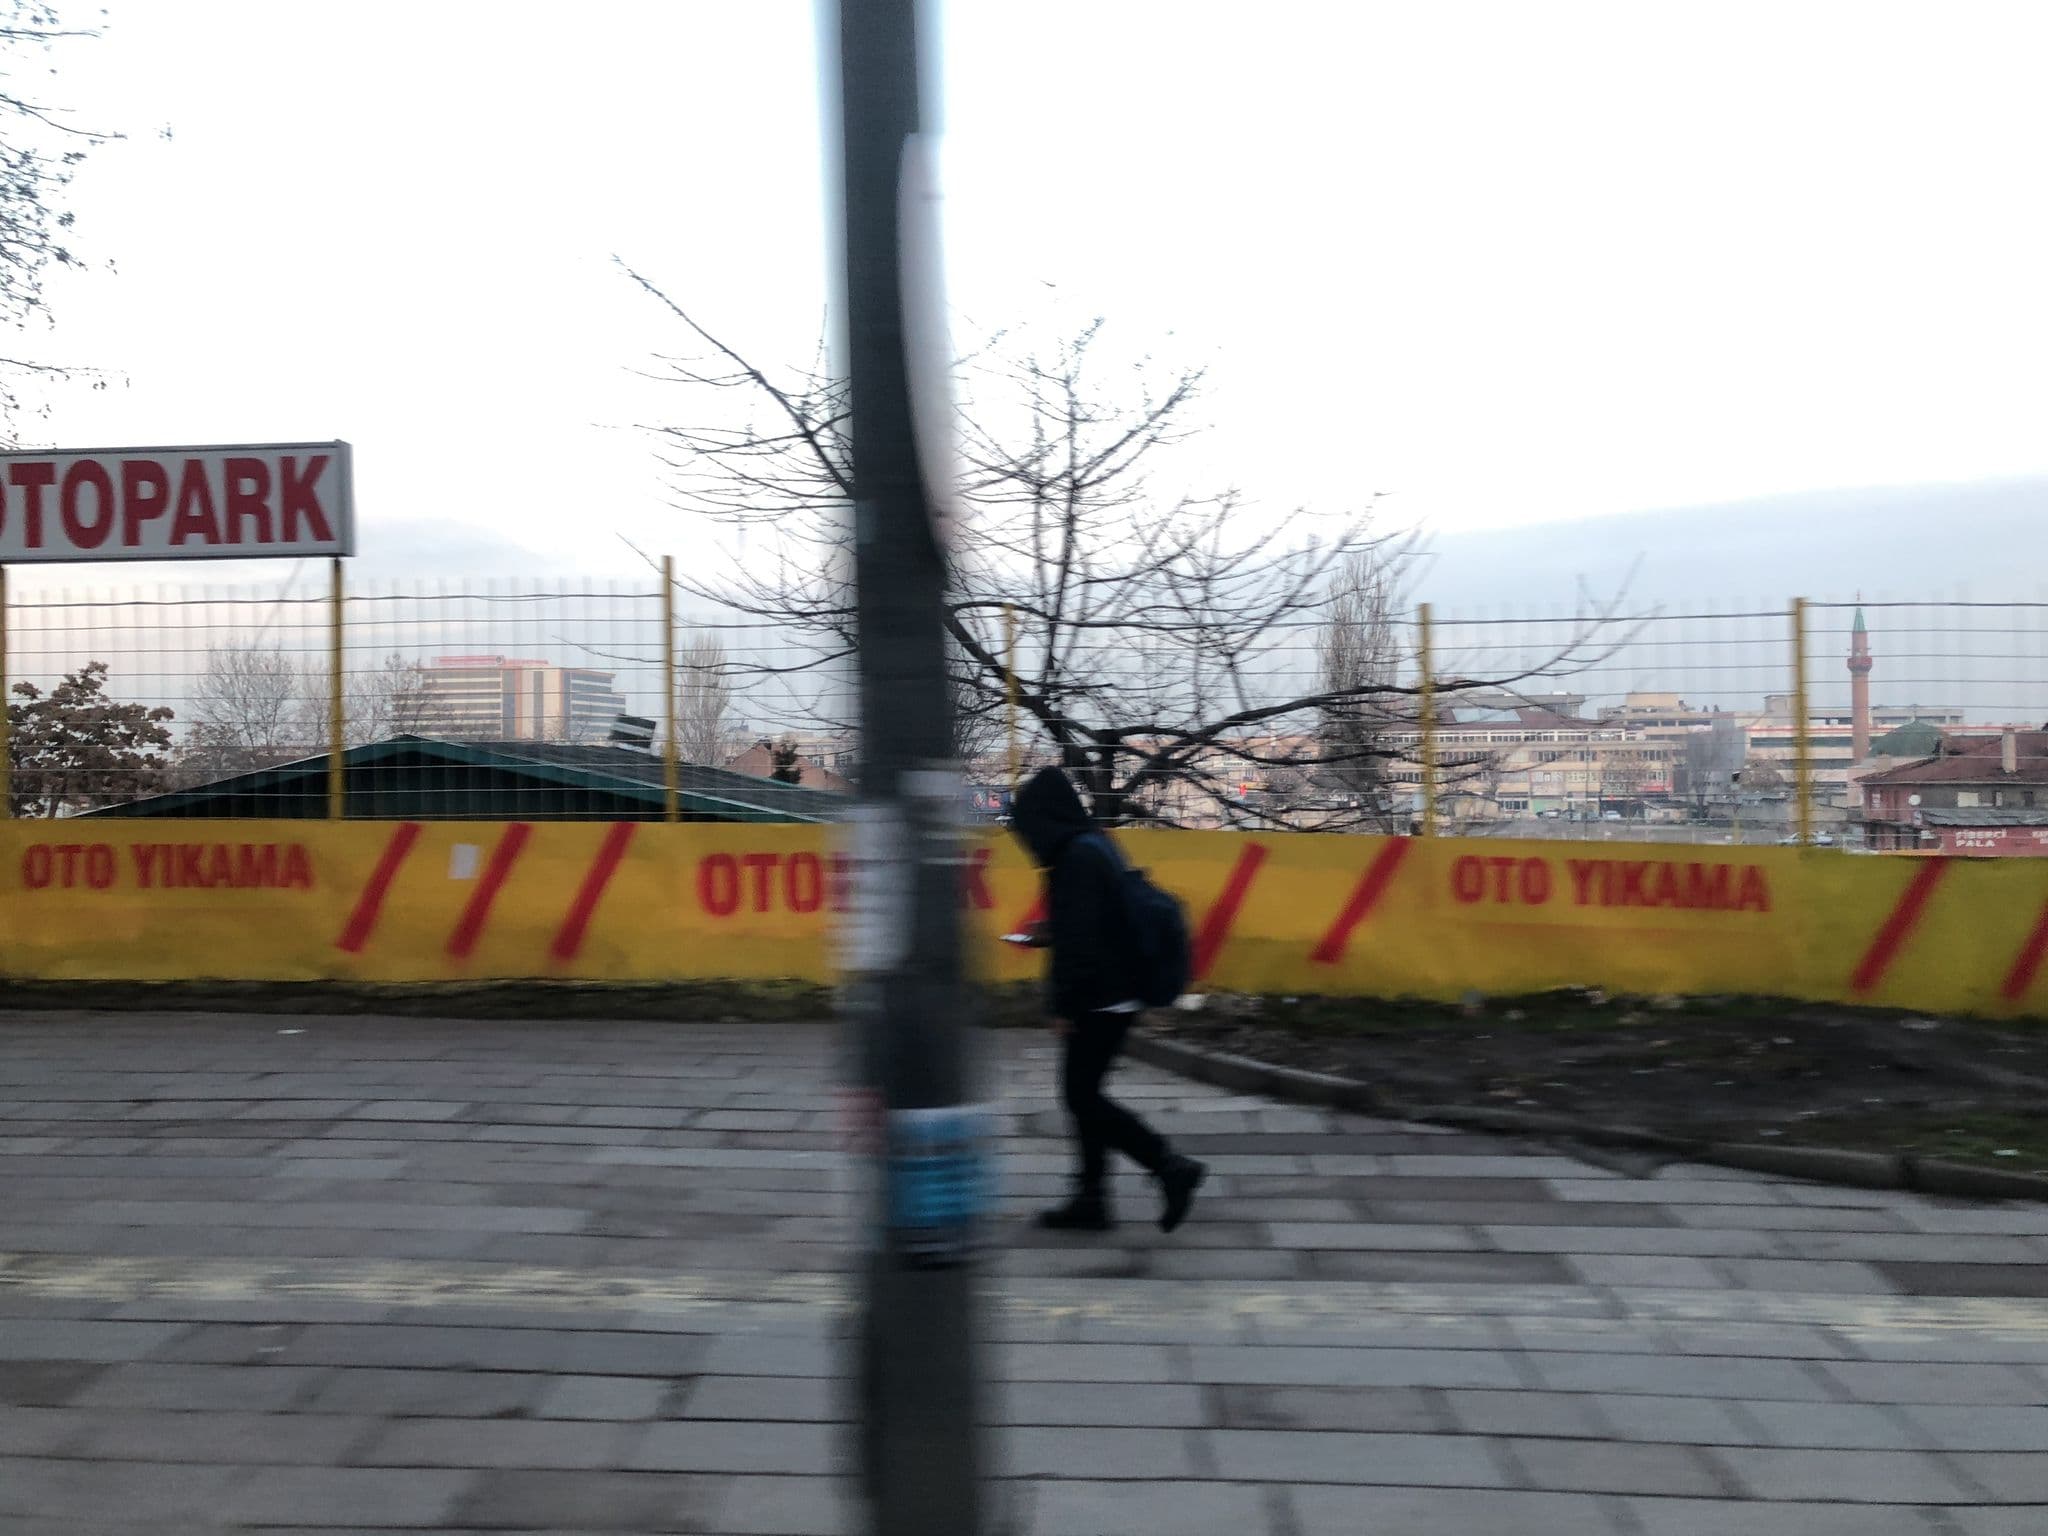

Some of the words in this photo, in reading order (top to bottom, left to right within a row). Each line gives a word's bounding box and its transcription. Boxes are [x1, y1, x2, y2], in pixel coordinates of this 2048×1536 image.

[0, 455, 335, 549] TOPARK
[22, 843, 116, 888] OTO
[130, 843, 314, 888] YIKAMA
[1453, 855, 1553, 905] OTO
[1566, 859, 1772, 912] YIKAMA
